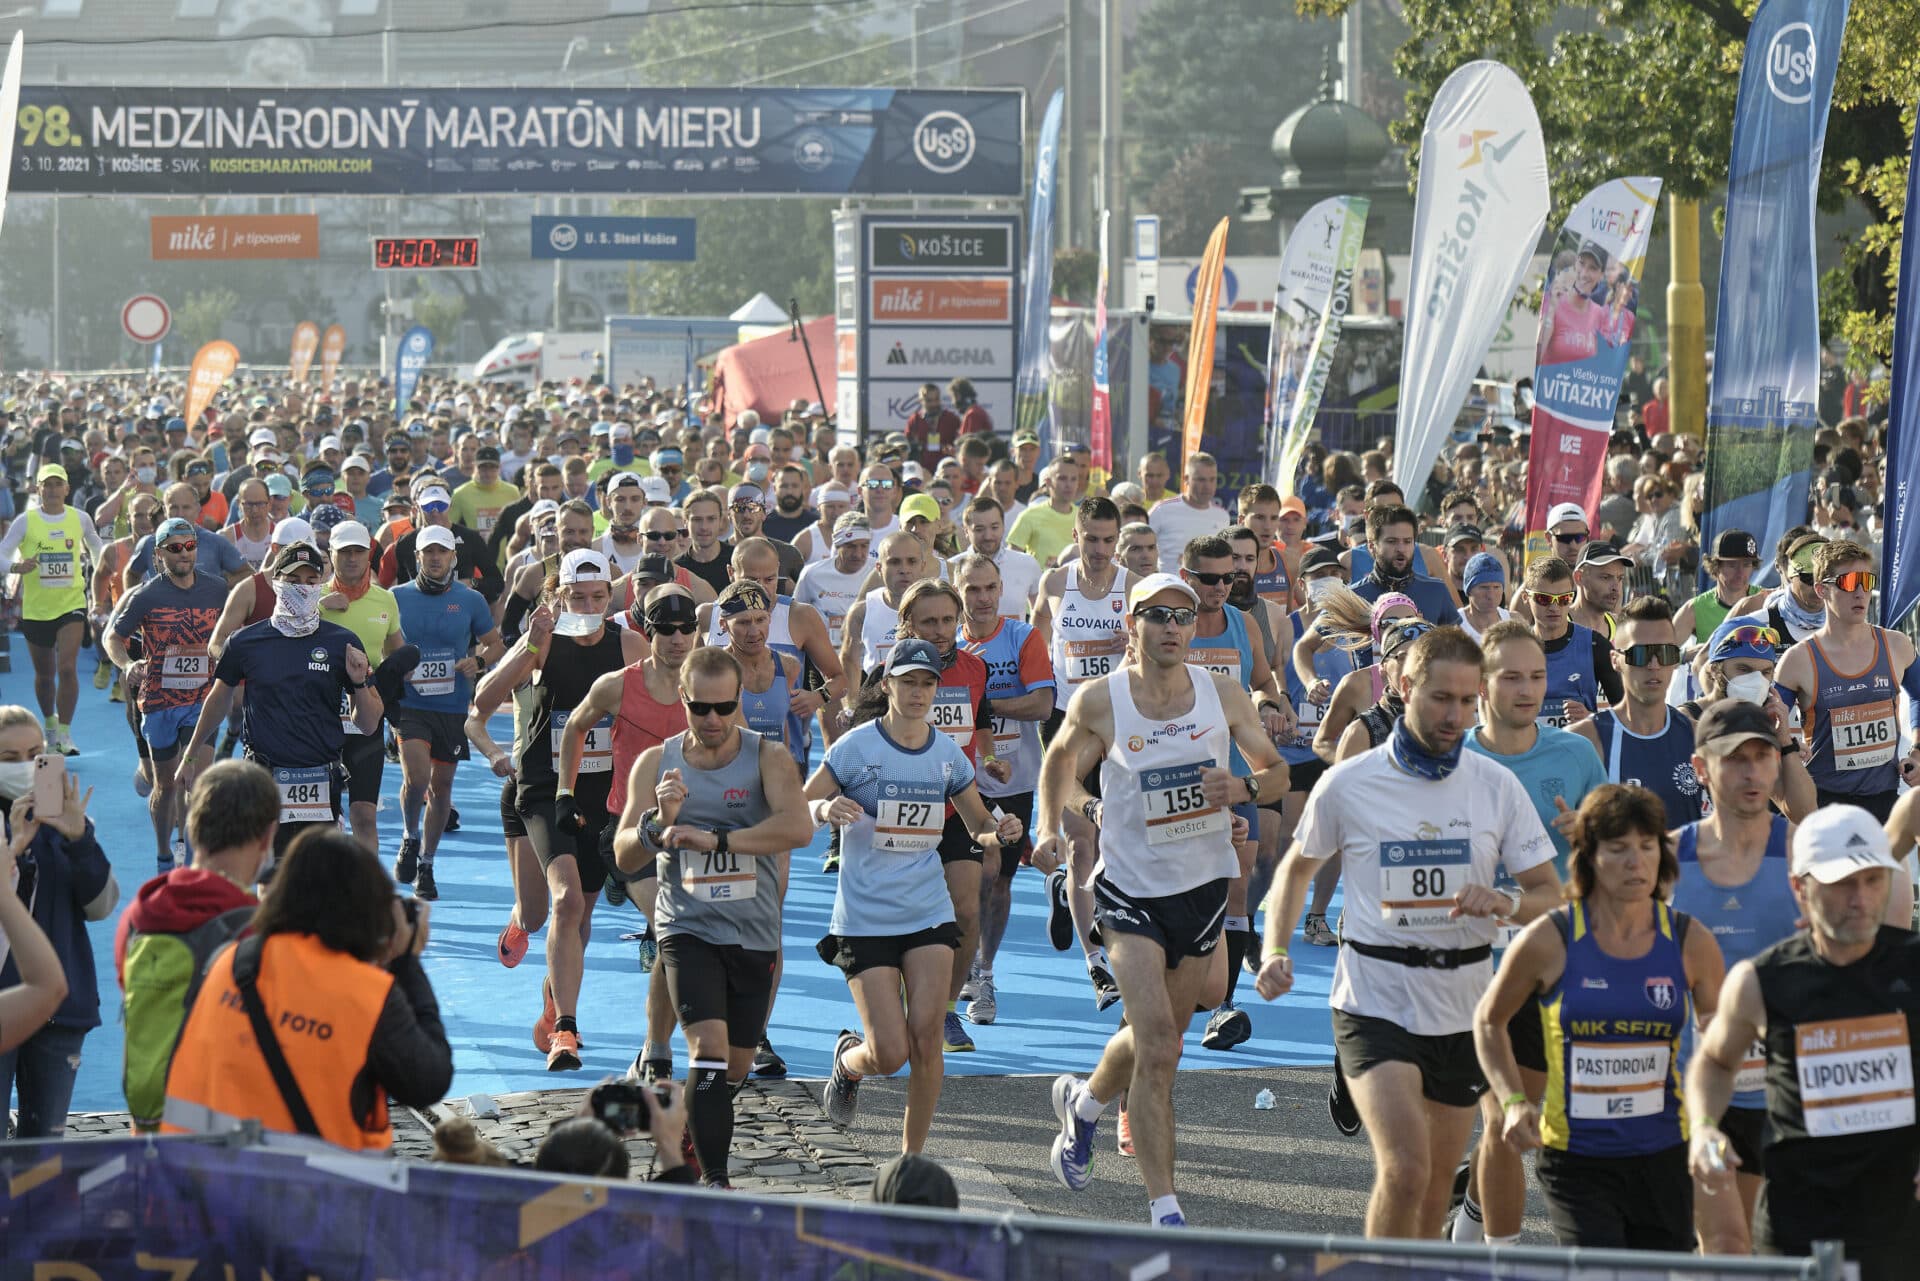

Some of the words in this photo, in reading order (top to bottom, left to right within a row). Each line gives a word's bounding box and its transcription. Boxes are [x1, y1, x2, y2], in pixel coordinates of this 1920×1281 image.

[18, 104, 82, 147] 98.
[636, 106, 761, 149] MIERU
[58, 157, 90, 172] 2021
[112, 152, 162, 173] KOŠICE
[172, 158, 199, 173] SVK
[209, 157, 372, 174] KOSICEMARATHON.COM
[614, 232, 641, 245] Steel
[643, 230, 678, 246] Košice
[917, 235, 984, 257] KOŠICE
[912, 348, 995, 366] MAGNA
[1573, 367, 1599, 384] Všetky
[1600, 375, 1618, 387] sme
[48, 563, 67, 575] 504
[1061, 616, 1122, 630] SLOVAKIA
[174, 657, 200, 673] 423
[421, 662, 447, 679] 329
[1080, 656, 1110, 678] 156
[933, 705, 963, 725] 364
[1844, 720, 1888, 747] 1146
[1857, 753, 1888, 767] MAGNA
[287, 784, 320, 803] 484
[1163, 784, 1205, 815] 155
[897, 803, 931, 827] F27
[1174, 820, 1208, 836] KOŠICE
[896, 841, 929, 849] MAGNA
[700, 850, 740, 874] 701
[1412, 867, 1445, 898] 80
[280, 1011, 334, 1041] FOTO
[1571, 1020, 1607, 1035] MK
[1576, 1055, 1657, 1076] PASTOROVÁ
[1803, 1052, 1898, 1089] LIPOVSKÝ
[1843, 1108, 1894, 1127] KOŠICE
